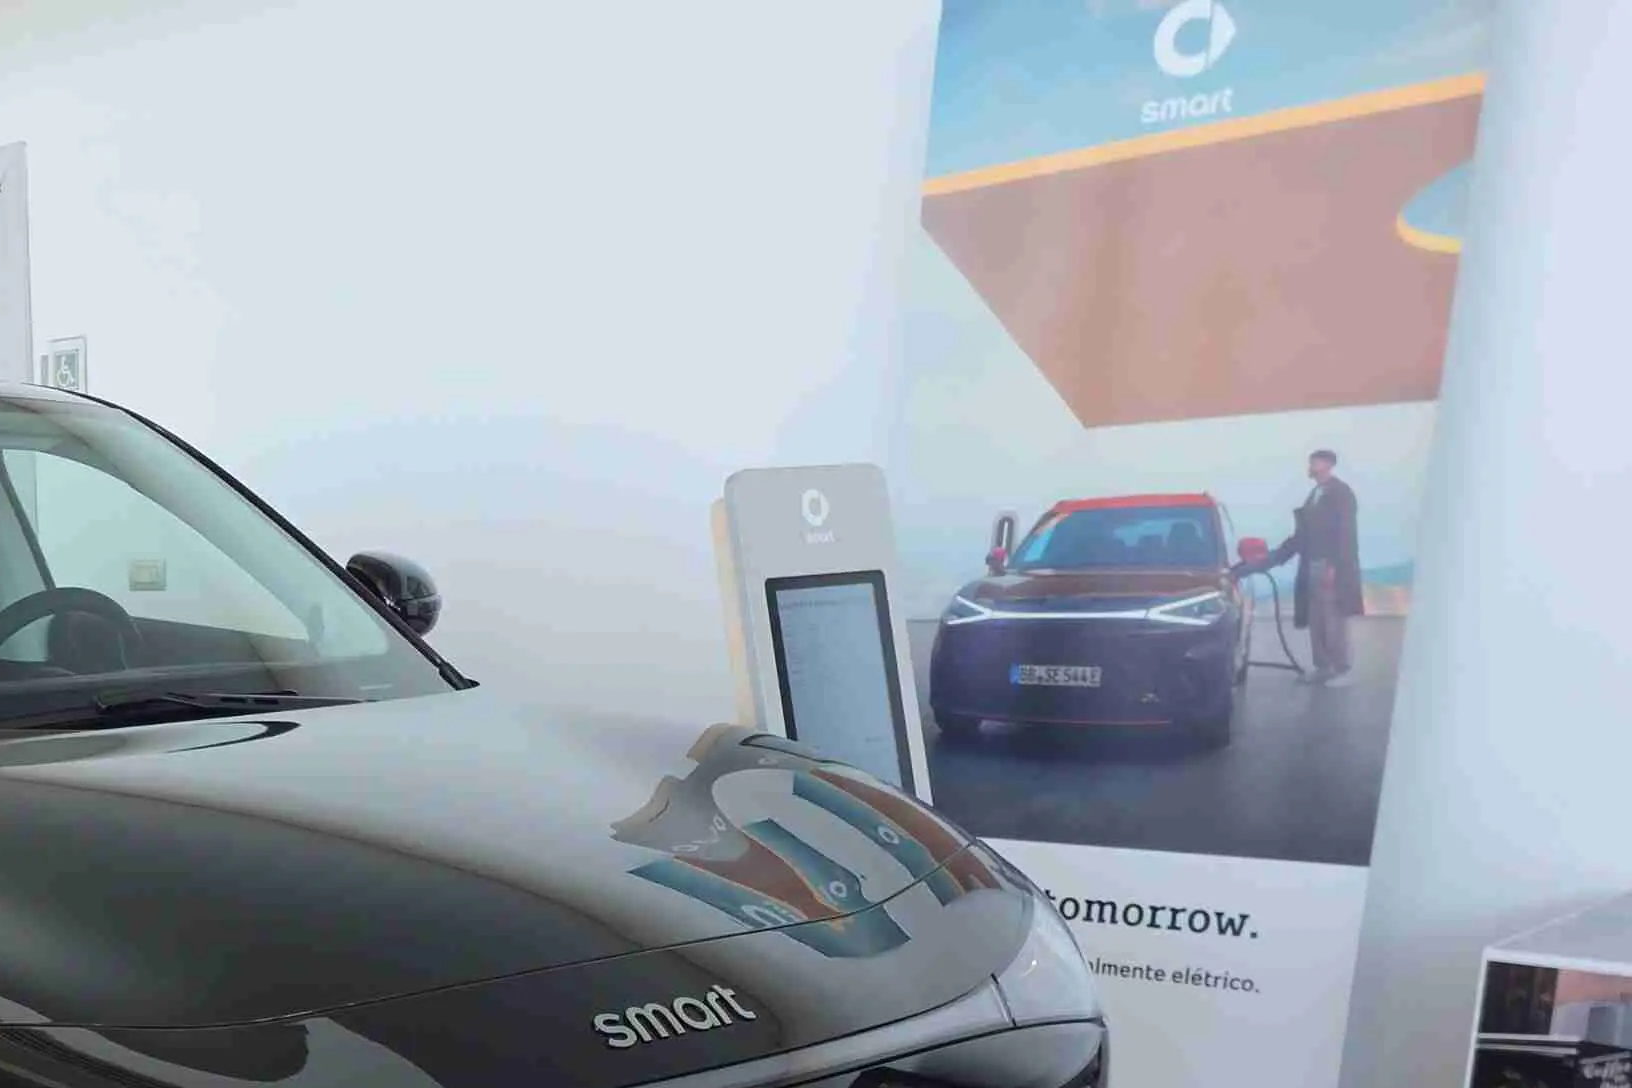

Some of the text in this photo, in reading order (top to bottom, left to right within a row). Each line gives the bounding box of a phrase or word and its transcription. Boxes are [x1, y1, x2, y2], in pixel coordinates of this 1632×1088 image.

[1140, 86, 1234, 124] smart
[1171, 966, 1261, 994] elétrico.
[593, 984, 757, 1048] smart
